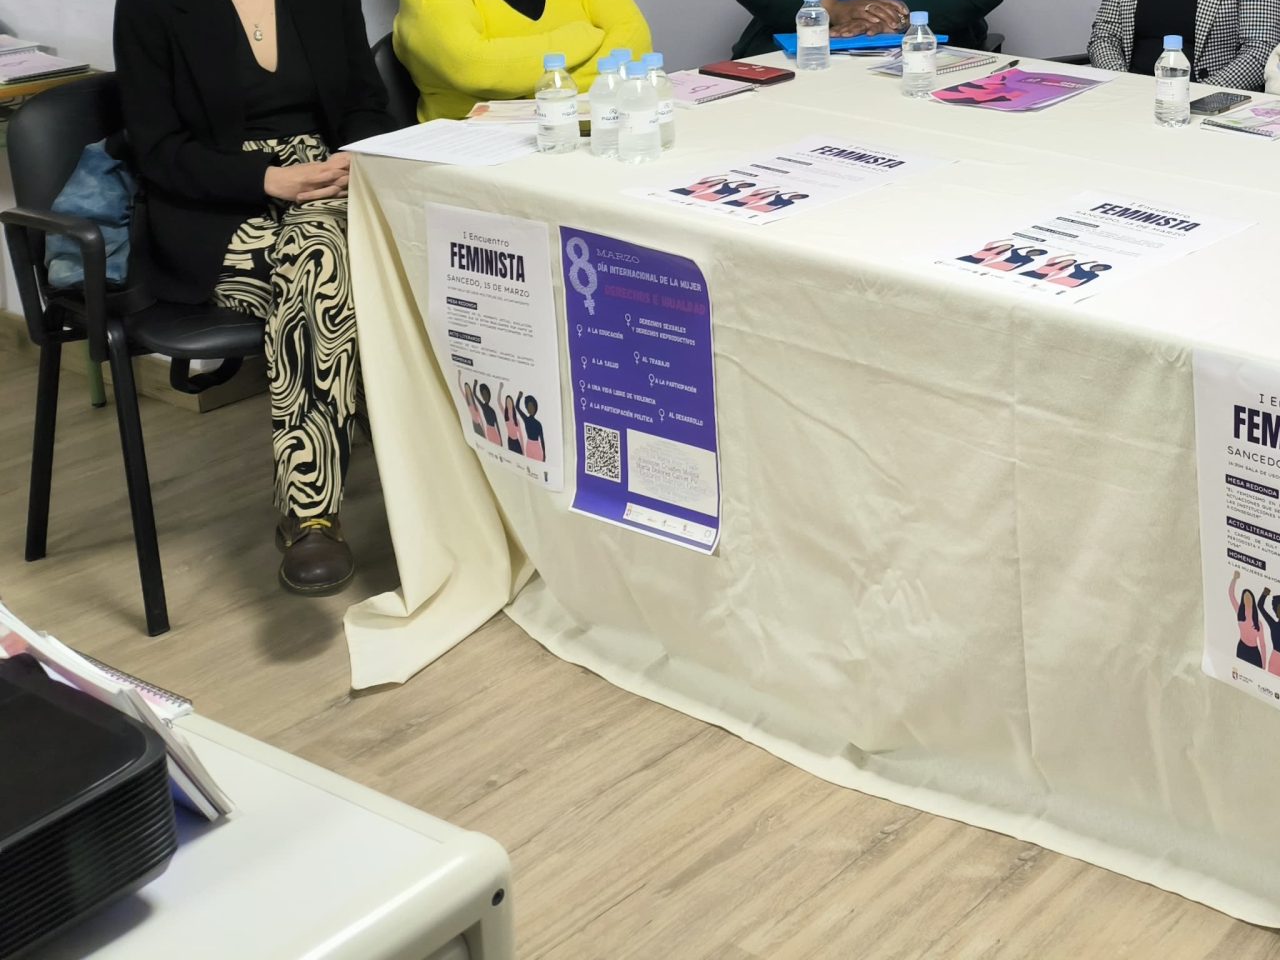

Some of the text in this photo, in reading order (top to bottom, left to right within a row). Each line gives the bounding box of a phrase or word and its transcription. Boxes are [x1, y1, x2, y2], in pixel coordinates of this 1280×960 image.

[810, 146, 906, 168] FEMINISTA
[1090, 203, 1201, 232] FEMINISTA
[469, 232, 510, 247] Encuentro
[450, 242, 525, 283] FEMINISTA
[596, 248, 640, 264] MARZO
[446, 274, 482, 289] SANCEDO,
[484, 282, 491, 290] 15
[504, 286, 530, 298] MARZO
[597, 261, 702, 293] DÍA INTERNACIONAL DE LA MUJER
[604, 285, 652, 303] DERECHOS
[653, 294, 659, 306] E
[1259, 393, 1265, 404] I
[1227, 476, 1278, 496] MESA REDONDA
[1228, 519, 1280, 541] ACTO LITERARIO
[1229, 551, 1263, 567] HOMENAJE
